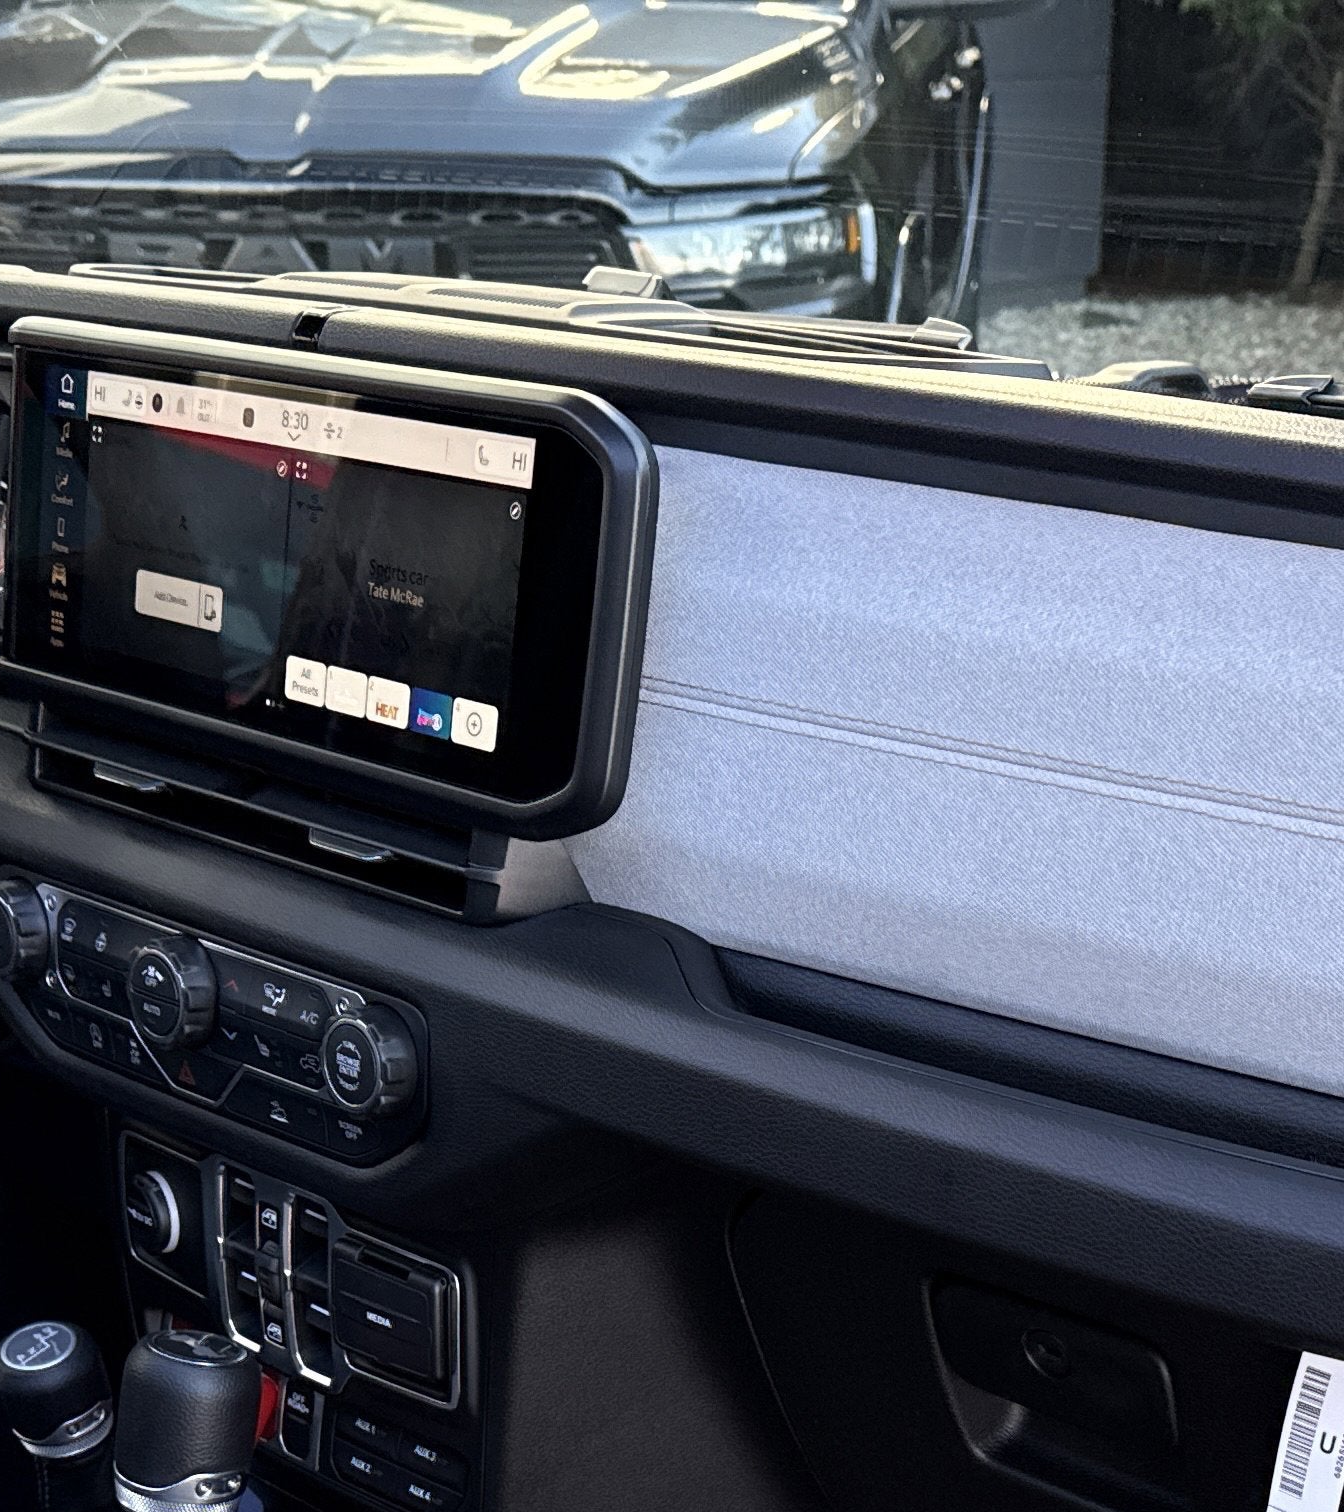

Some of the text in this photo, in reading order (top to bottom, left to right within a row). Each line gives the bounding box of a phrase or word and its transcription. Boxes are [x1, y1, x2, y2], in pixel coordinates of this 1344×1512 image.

[107, 231, 435, 273] RAM
[95, 385, 106, 402] HI
[281, 410, 309, 431] 8:30
[512, 451, 527, 472] HI
[368, 581, 425, 608] Tate McRae
[292, 681, 319, 697] Presets
[375, 701, 399, 721] HEAT
[300, 1010, 319, 1025] A/C
[366, 1311, 392, 1329] MEDIA
[1320, 1431, 1337, 1454] U
